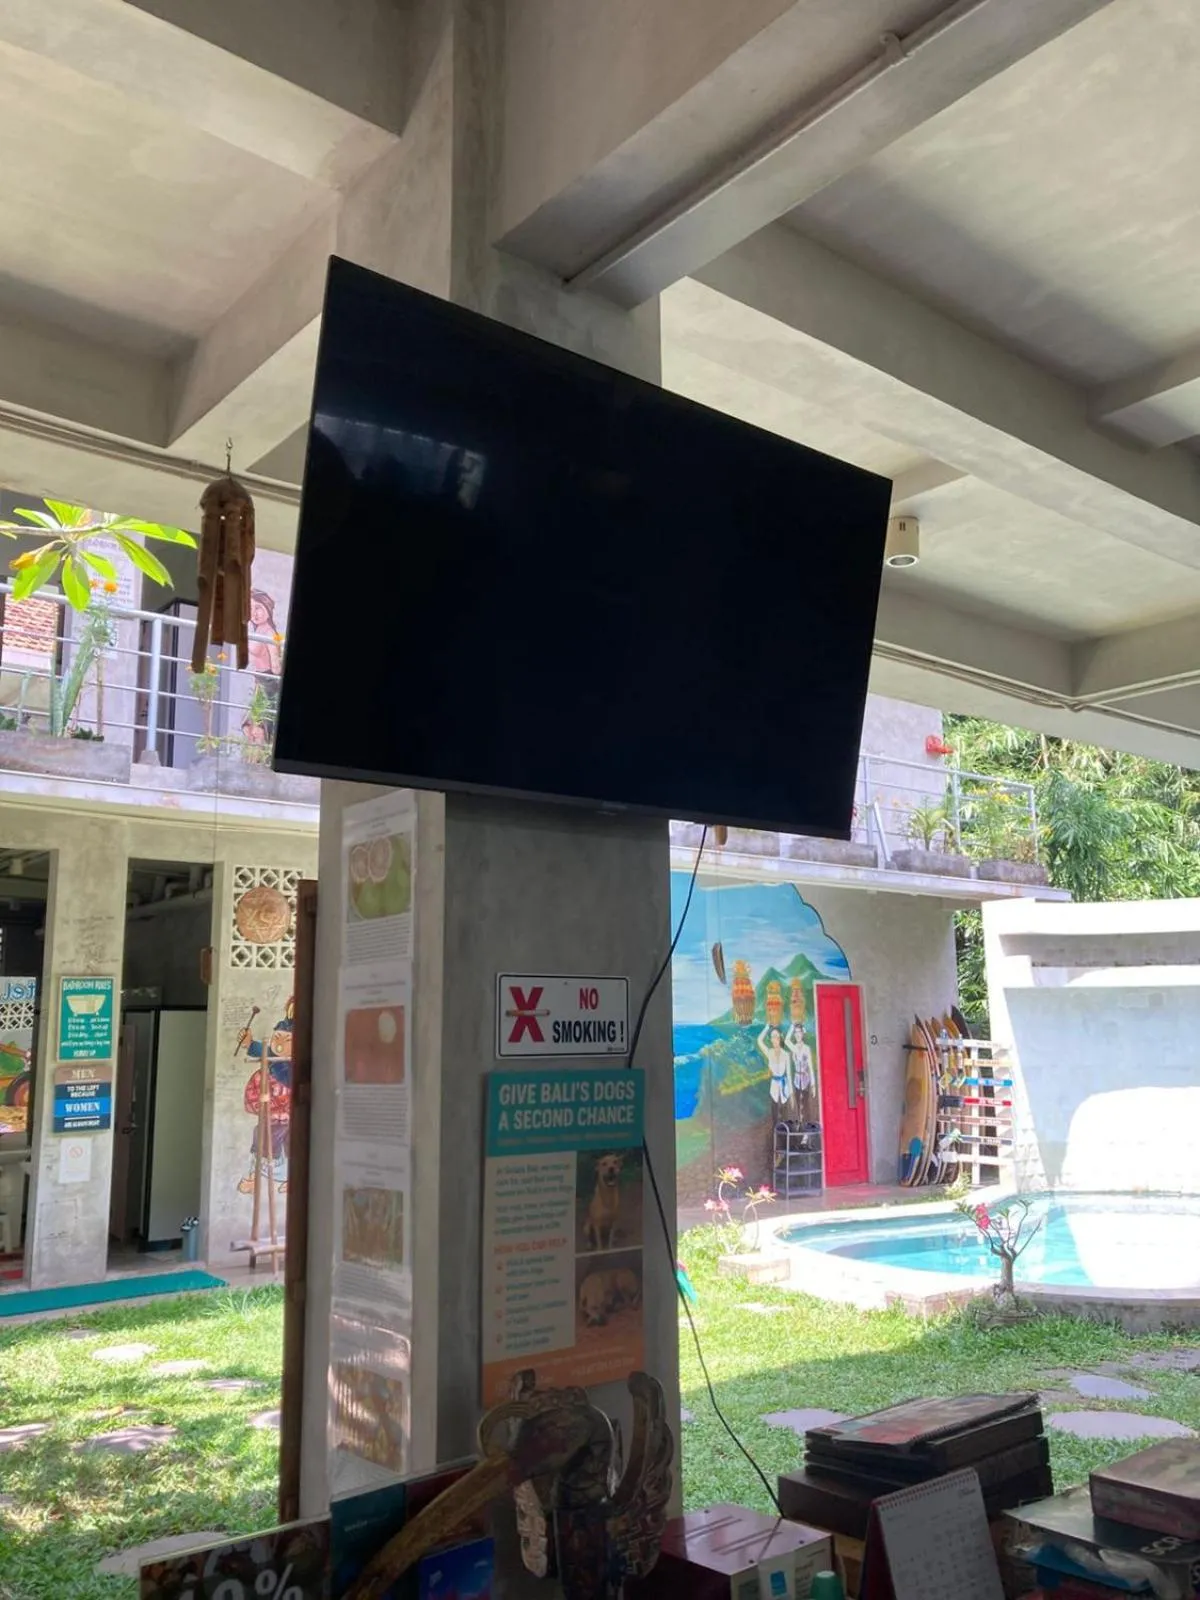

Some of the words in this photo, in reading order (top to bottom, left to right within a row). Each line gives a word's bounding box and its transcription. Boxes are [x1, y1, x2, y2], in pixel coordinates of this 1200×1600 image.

[579, 987, 599, 1011] NO
[71, 1069, 97, 1079] MEN
[500, 1084, 537, 1106] GIVE
[541, 1082, 590, 1104] BALI'S
[595, 1080, 635, 1101] DOGS
[64, 1101, 101, 1113] WOMEN
[498, 1111, 509, 1132] A
[514, 1109, 574, 1131] SECOND
[579, 1106, 635, 1127] CHANCE
